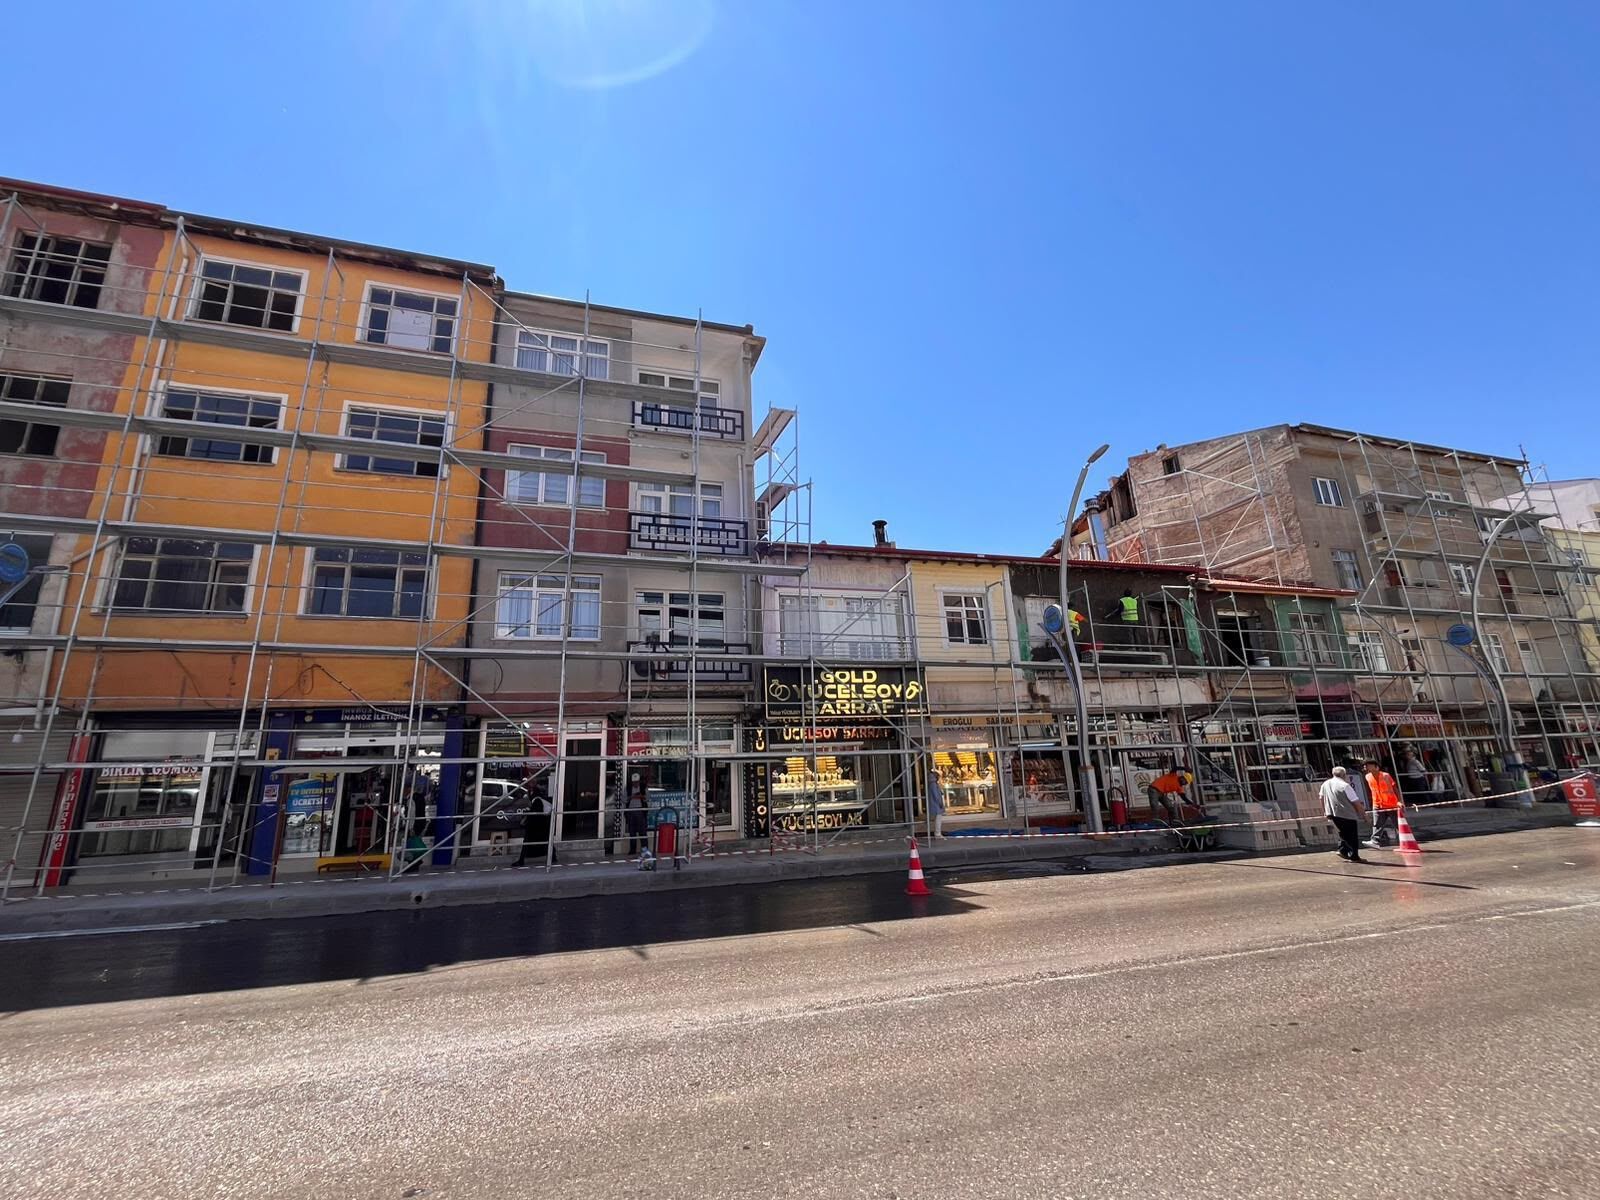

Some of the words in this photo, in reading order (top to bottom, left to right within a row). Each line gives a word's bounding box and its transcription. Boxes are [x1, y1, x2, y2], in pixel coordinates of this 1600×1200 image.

[820, 670, 877, 683] GOLD
[792, 679, 903, 699] YÜCELSOY
[805, 699, 895, 715] SARRAF
[943, 717, 973, 726] EROĞLU
[985, 717, 1014, 725] SARRAF
